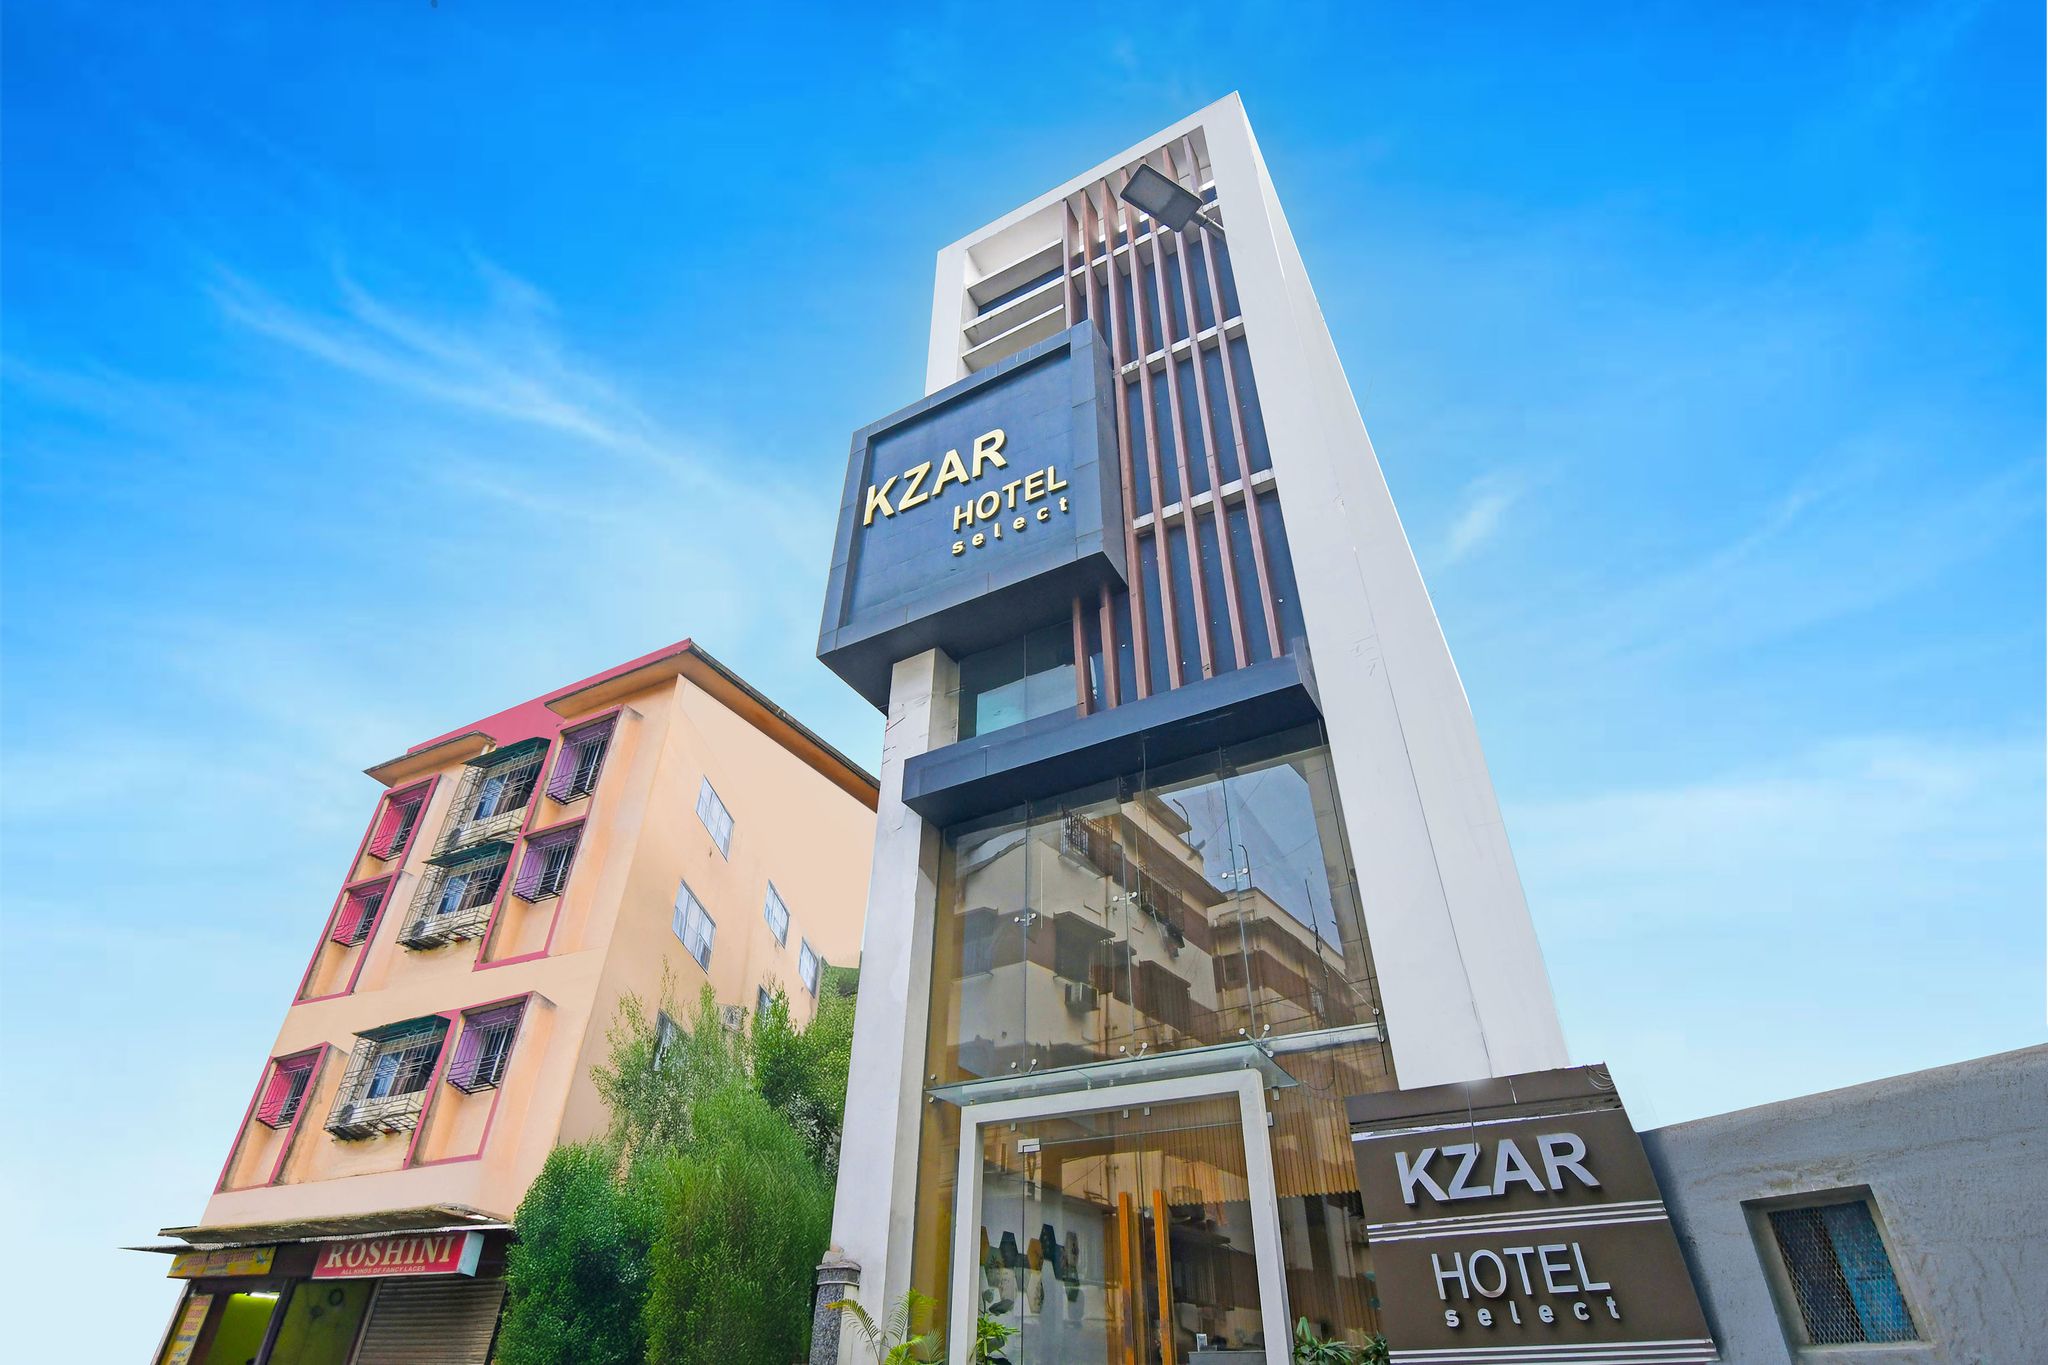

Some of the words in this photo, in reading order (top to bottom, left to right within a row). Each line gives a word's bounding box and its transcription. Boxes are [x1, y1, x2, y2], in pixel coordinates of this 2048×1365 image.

[863, 428, 1008, 527] KZAR
[953, 465, 1068, 532] HOTEL
[952, 496, 1068, 556] select
[1394, 1132, 1600, 1204] KZAR
[324, 1236, 455, 1268] ROSHINI
[1431, 1242, 1612, 1300] HOTEL
[1444, 1296, 1621, 1328] select
